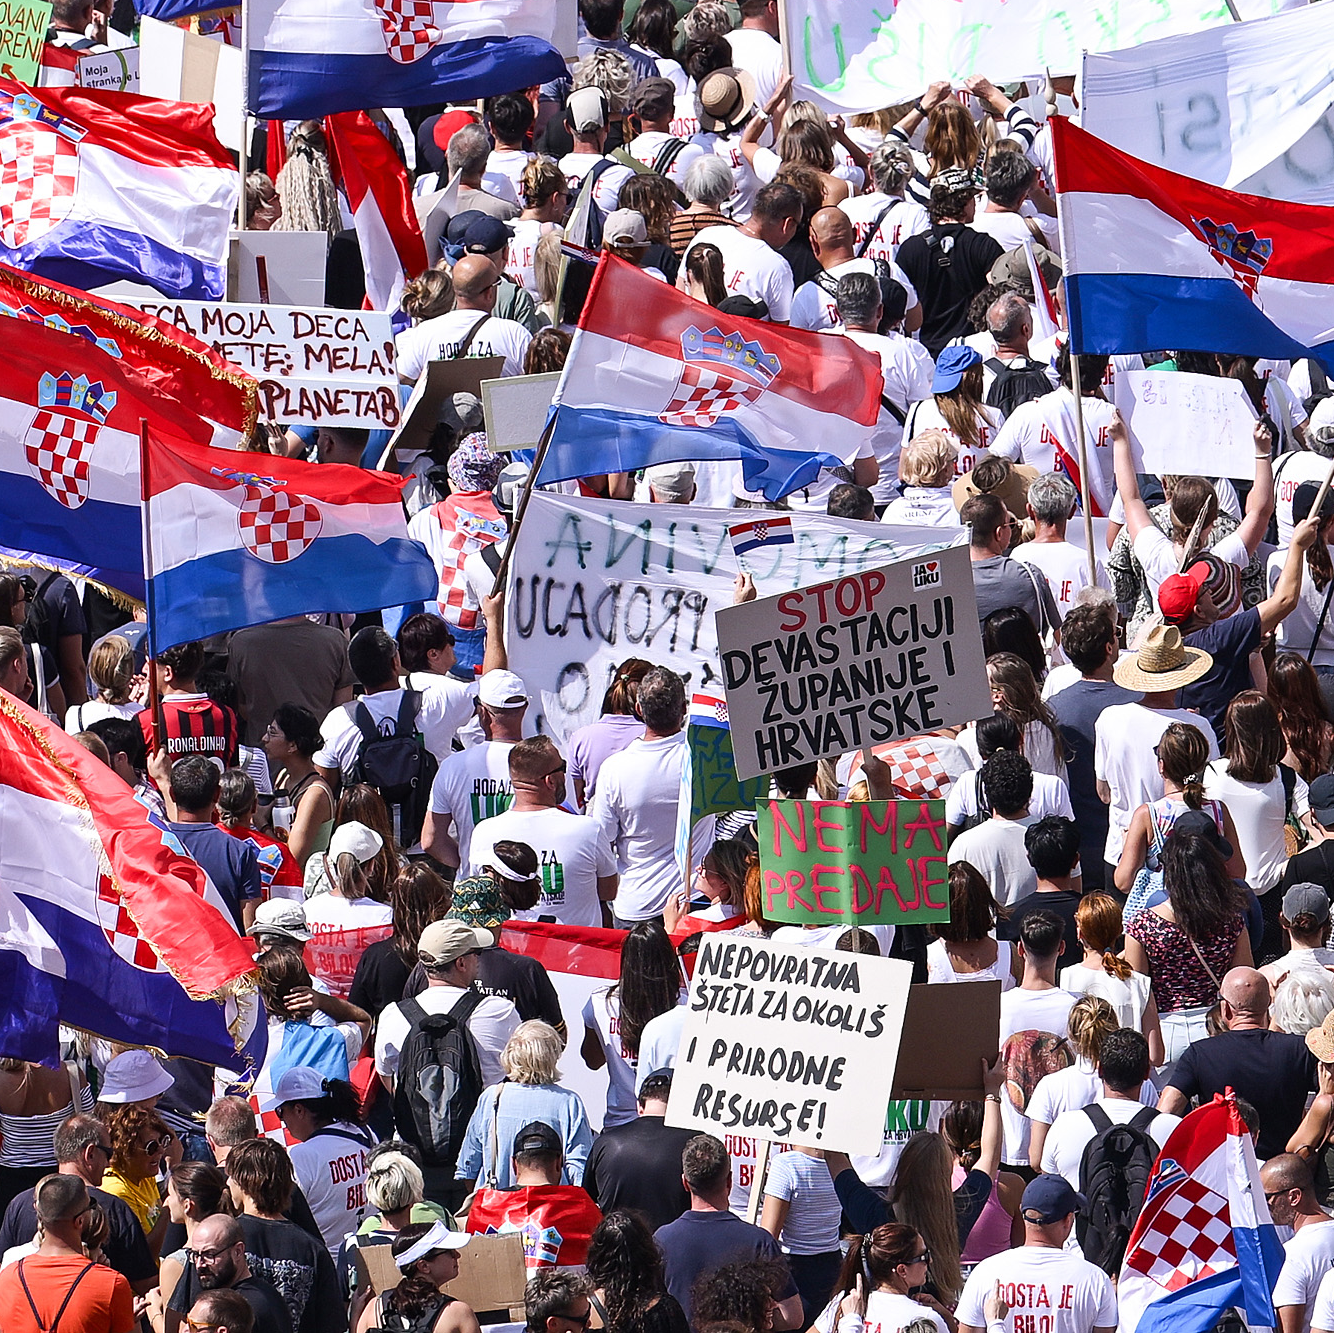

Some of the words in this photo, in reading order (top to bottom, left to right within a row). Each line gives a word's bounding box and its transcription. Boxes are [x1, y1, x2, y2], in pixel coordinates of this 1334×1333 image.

[85, 65, 109, 78] Moja
[201, 307, 275, 340] MOJA
[289, 311, 370, 343] DECA
[304, 341, 397, 376] MELA!
[913, 564, 927, 577] JA
[913, 572, 941, 589] LIKU
[777, 570, 886, 633] STOP
[721, 595, 955, 692] DEVASTACIJI
[757, 646, 932, 724] ŽUPANIJE
[942, 640, 957, 677] I
[167, 736, 225, 755] RONALDINHO
[754, 684, 945, 771] HRVATSKE
[768, 801, 946, 858] NEMA
[764, 856, 948, 916] PREDAJE
[697, 941, 861, 994] NEPOVRATNA
[692, 978, 754, 1018] ŠTETA
[758, 990, 787, 1021] ZA
[792, 995, 888, 1038] OKOLIŠ
[686, 1037, 698, 1063] I
[708, 1038, 847, 1092] PRIRODNE
[693, 1083, 828, 1140] RESURSE!
[1059, 1283, 1073, 1310] JE
